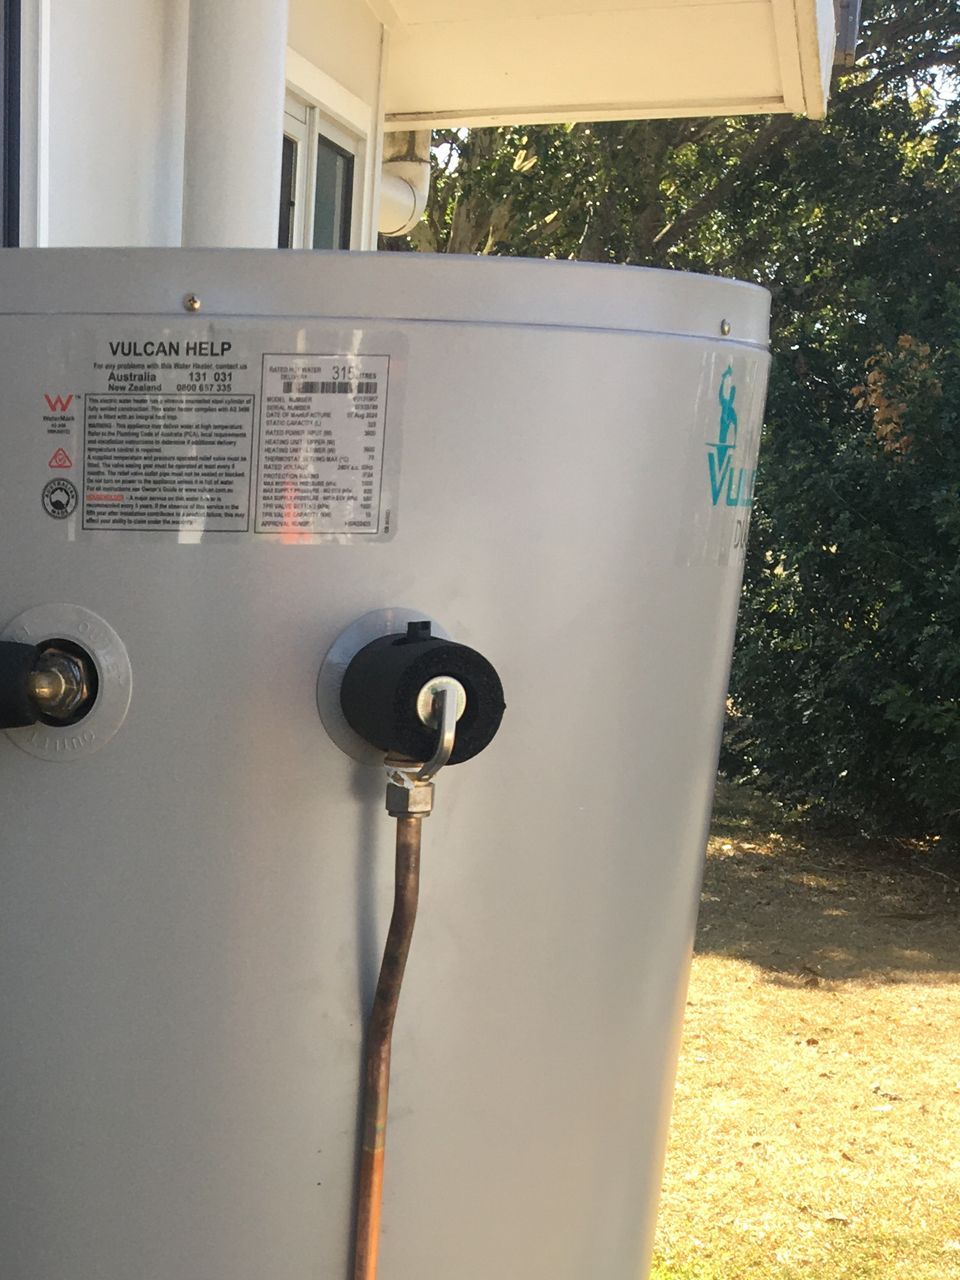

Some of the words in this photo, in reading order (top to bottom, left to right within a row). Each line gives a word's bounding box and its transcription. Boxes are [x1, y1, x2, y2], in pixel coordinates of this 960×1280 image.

[109, 341, 179, 356] VULCAN
[186, 342, 232, 357] HELP
[108, 371, 157, 382] Australia
[189, 372, 207, 382] 131
[214, 372, 233, 382] 031
[108, 384, 126, 392] New
[128, 384, 162, 392] Zealand
